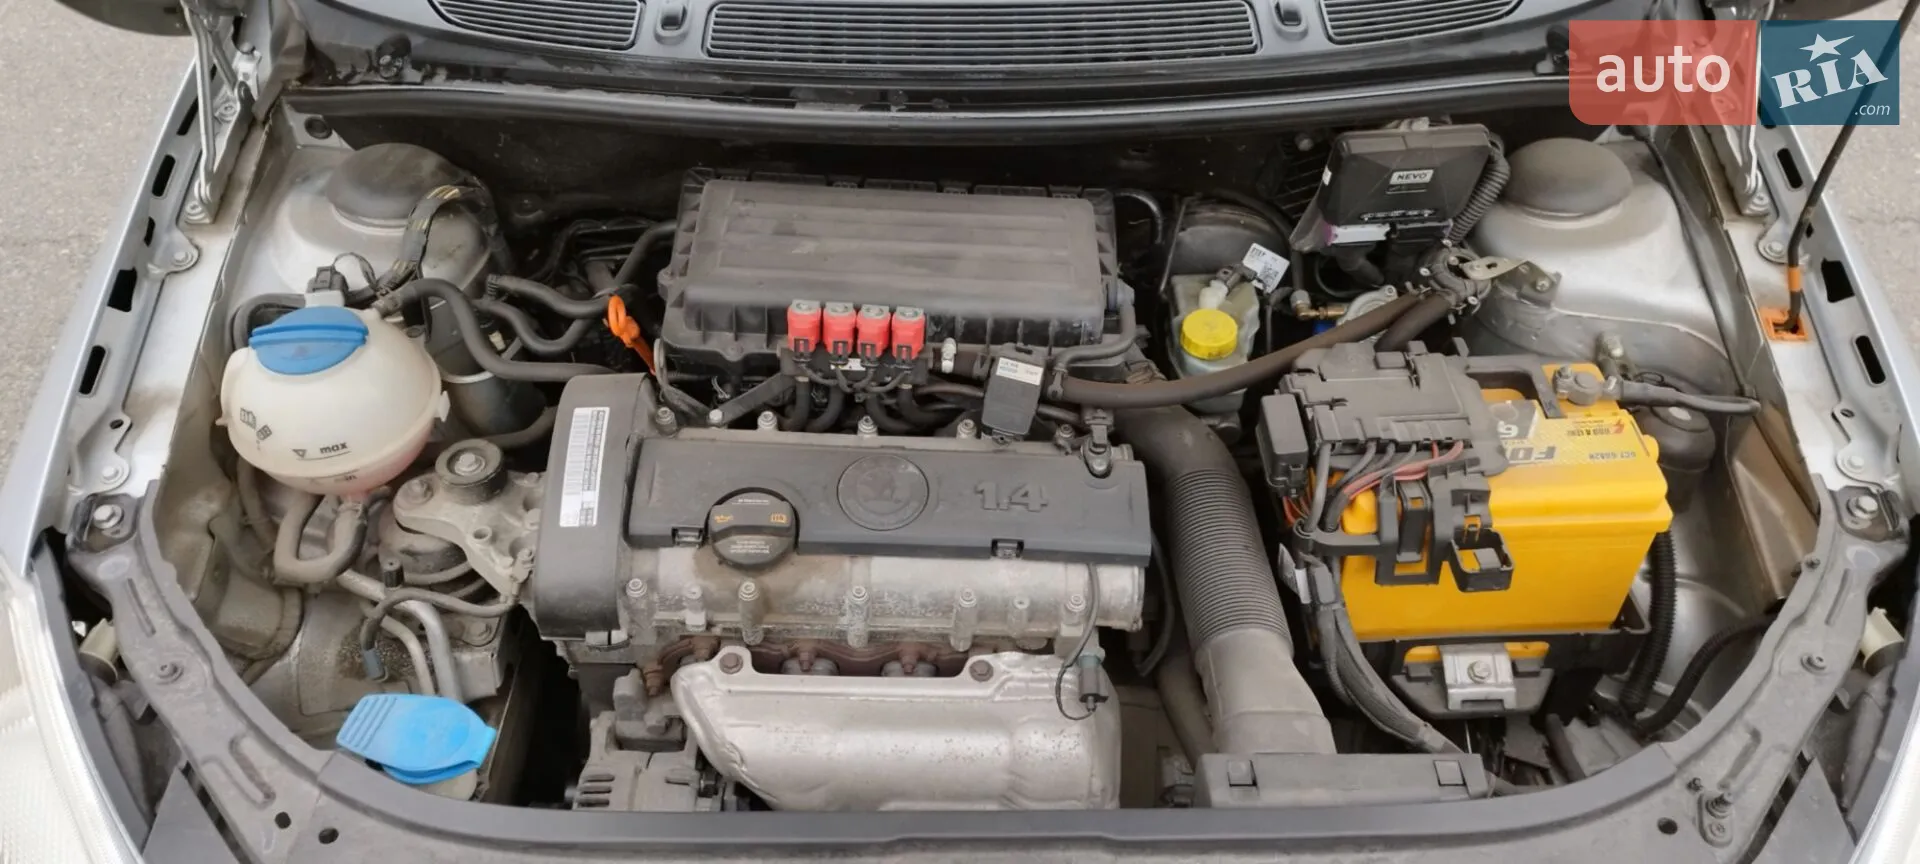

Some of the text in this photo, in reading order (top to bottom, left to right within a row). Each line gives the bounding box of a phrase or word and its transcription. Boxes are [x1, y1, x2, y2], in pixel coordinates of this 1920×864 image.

[1397, 173, 1428, 181] NEVO
[320, 442, 348, 454] max
[1508, 446, 1556, 461] FO
[974, 481, 1049, 512] 1.4
